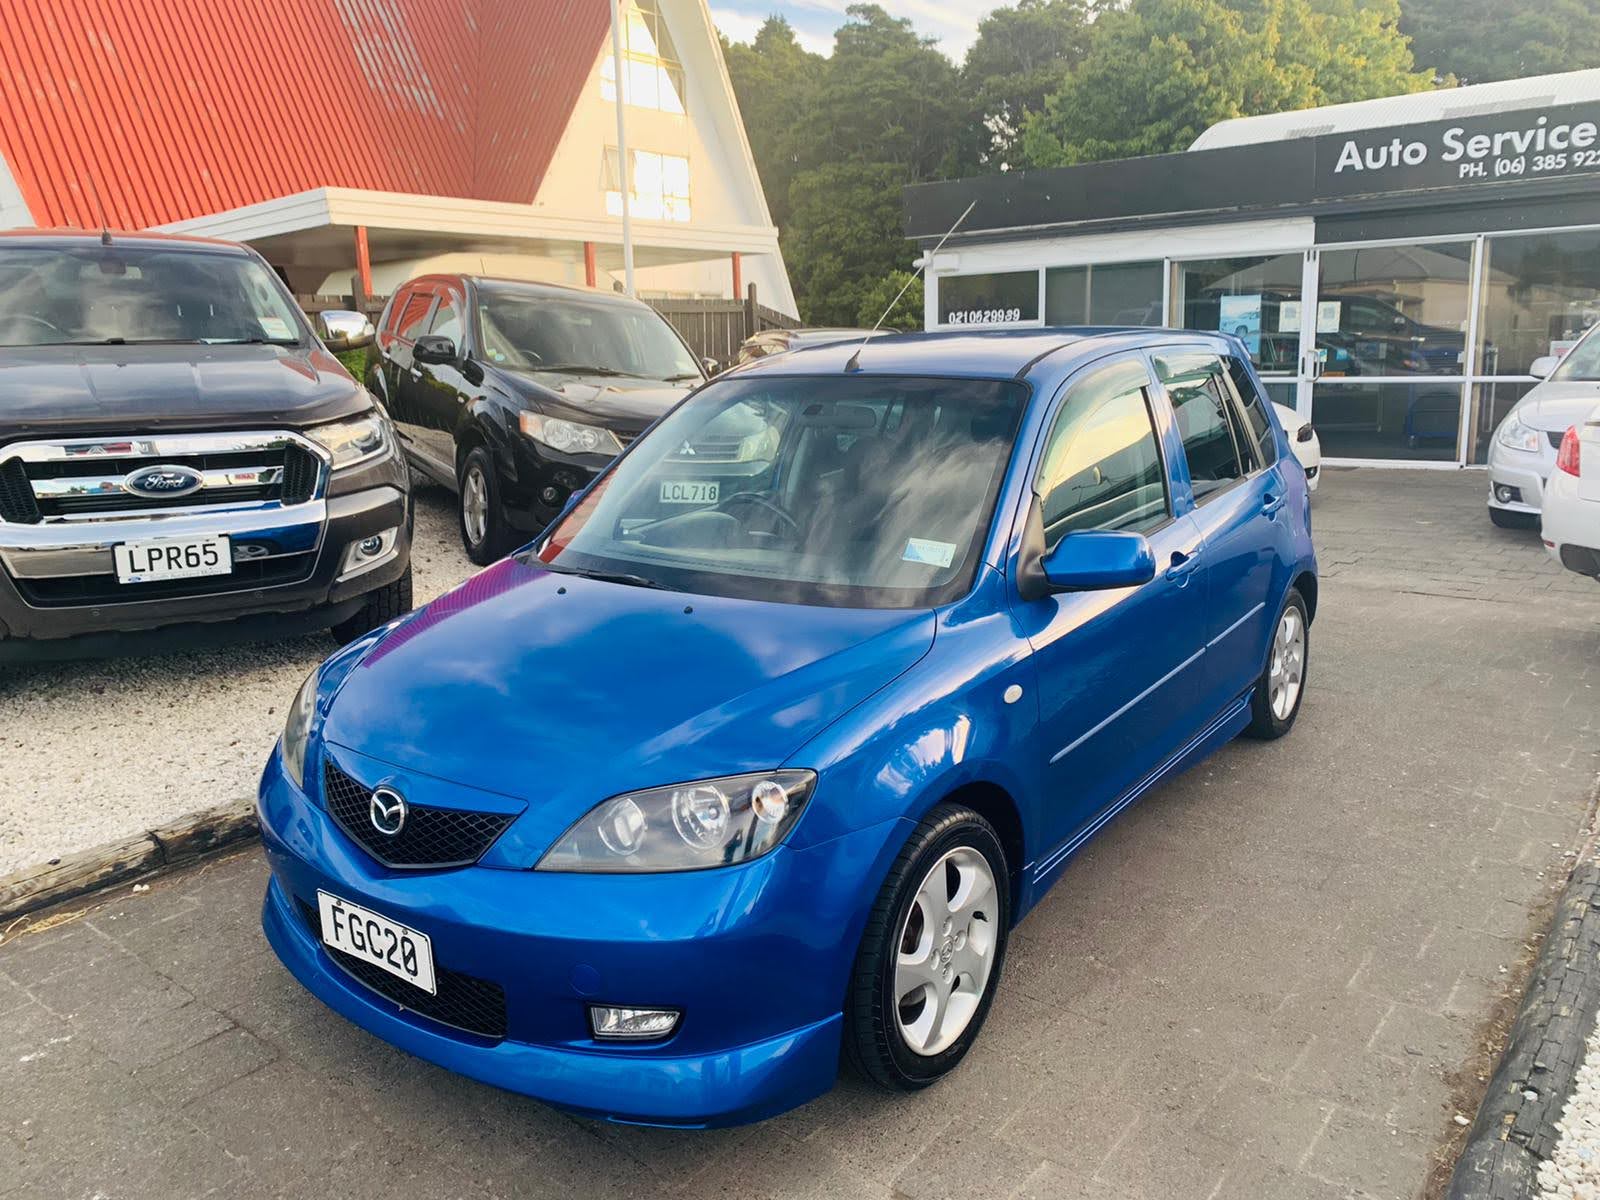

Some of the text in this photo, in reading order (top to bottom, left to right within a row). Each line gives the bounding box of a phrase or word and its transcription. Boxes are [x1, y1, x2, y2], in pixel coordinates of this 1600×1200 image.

[1334, 116, 1598, 173] Auto Service
[1459, 162, 1488, 178] PH.
[1494, 155, 1526, 177] (06)
[1531, 153, 1568, 171] 385
[144, 473, 185, 490] Ford
[662, 485, 717, 501] LCL718
[128, 543, 218, 573] LPR65
[331, 904, 418, 977] FGC20
